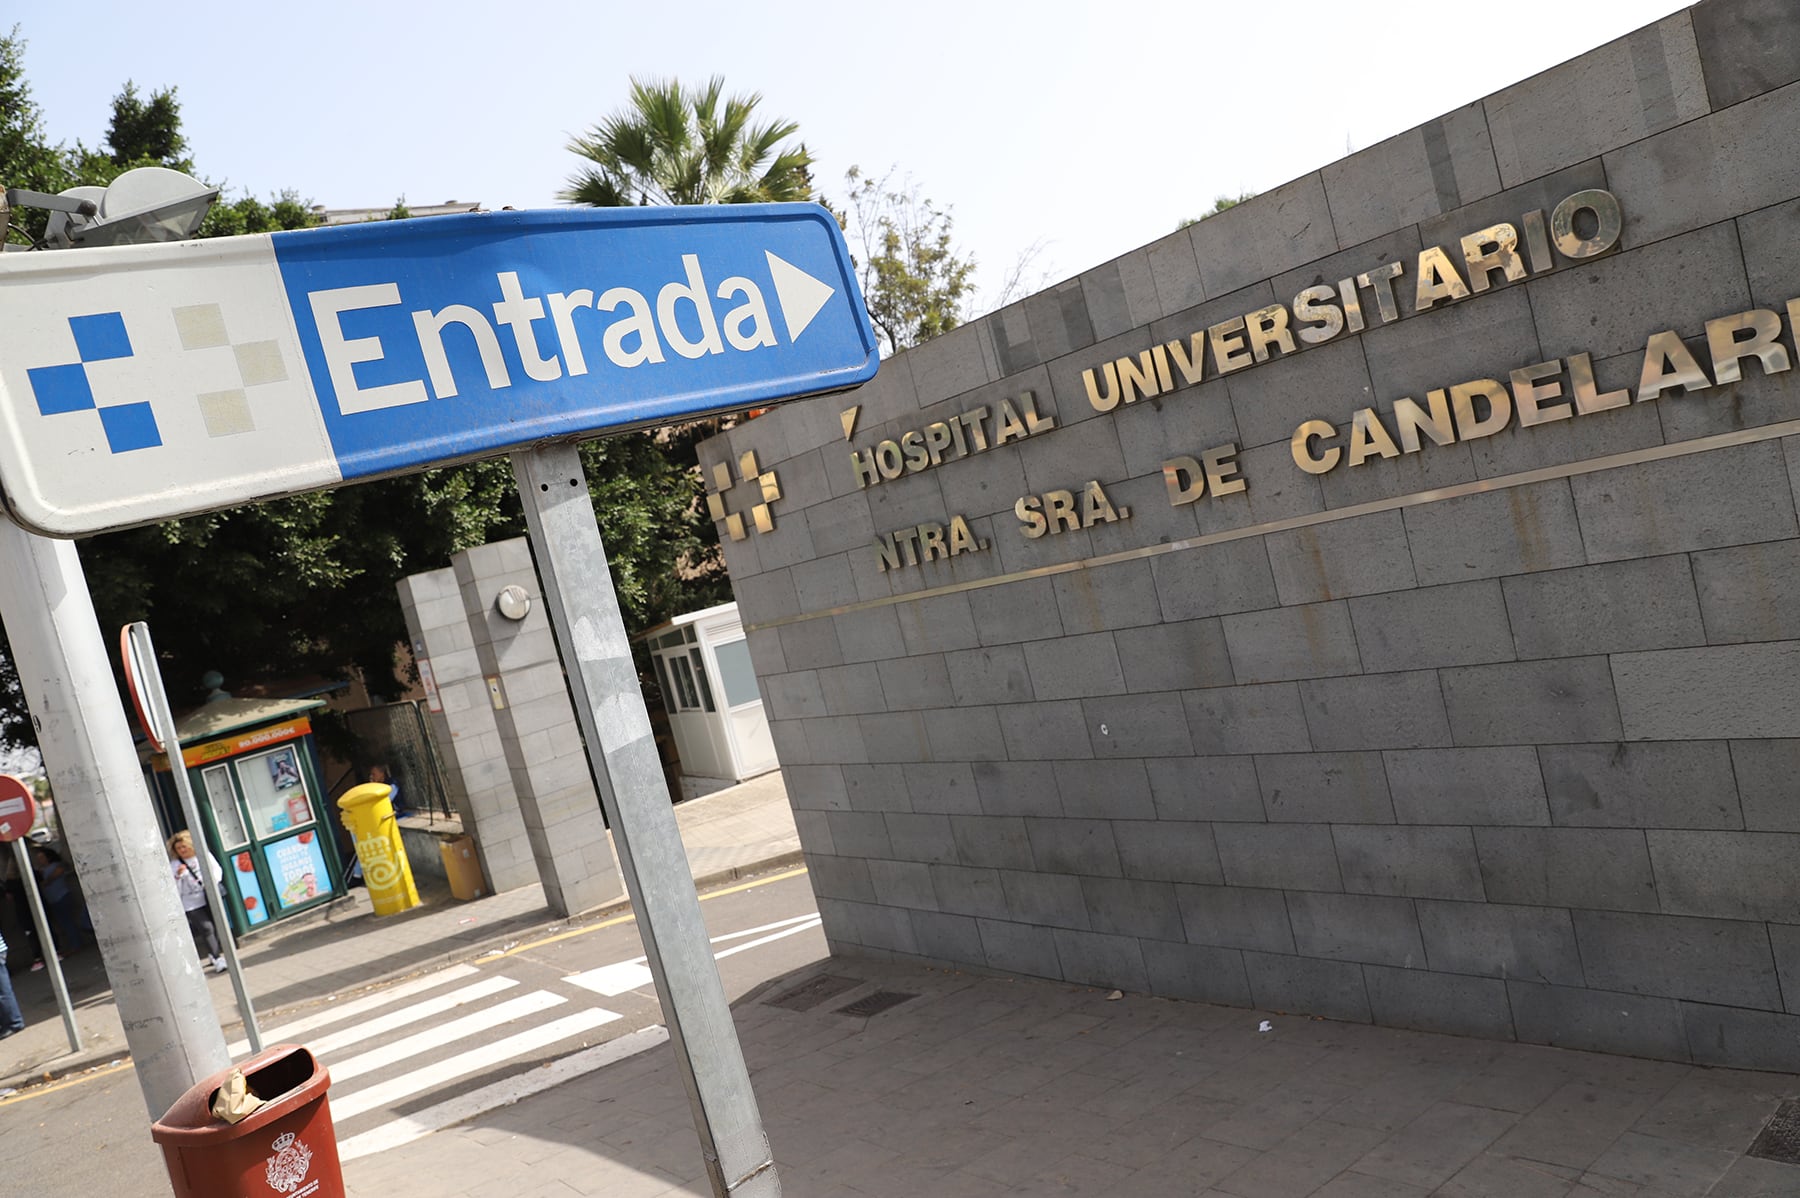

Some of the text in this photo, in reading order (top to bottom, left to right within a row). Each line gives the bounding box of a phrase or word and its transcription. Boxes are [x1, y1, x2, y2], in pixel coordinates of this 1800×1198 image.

[308, 253, 777, 416] Entrada
[850, 188, 1622, 489] HOSPITAL UNIVERSITARIO
[873, 514, 989, 573] NTRA.
[1014, 480, 1130, 539] SRA.
[1162, 443, 1247, 506] DE
